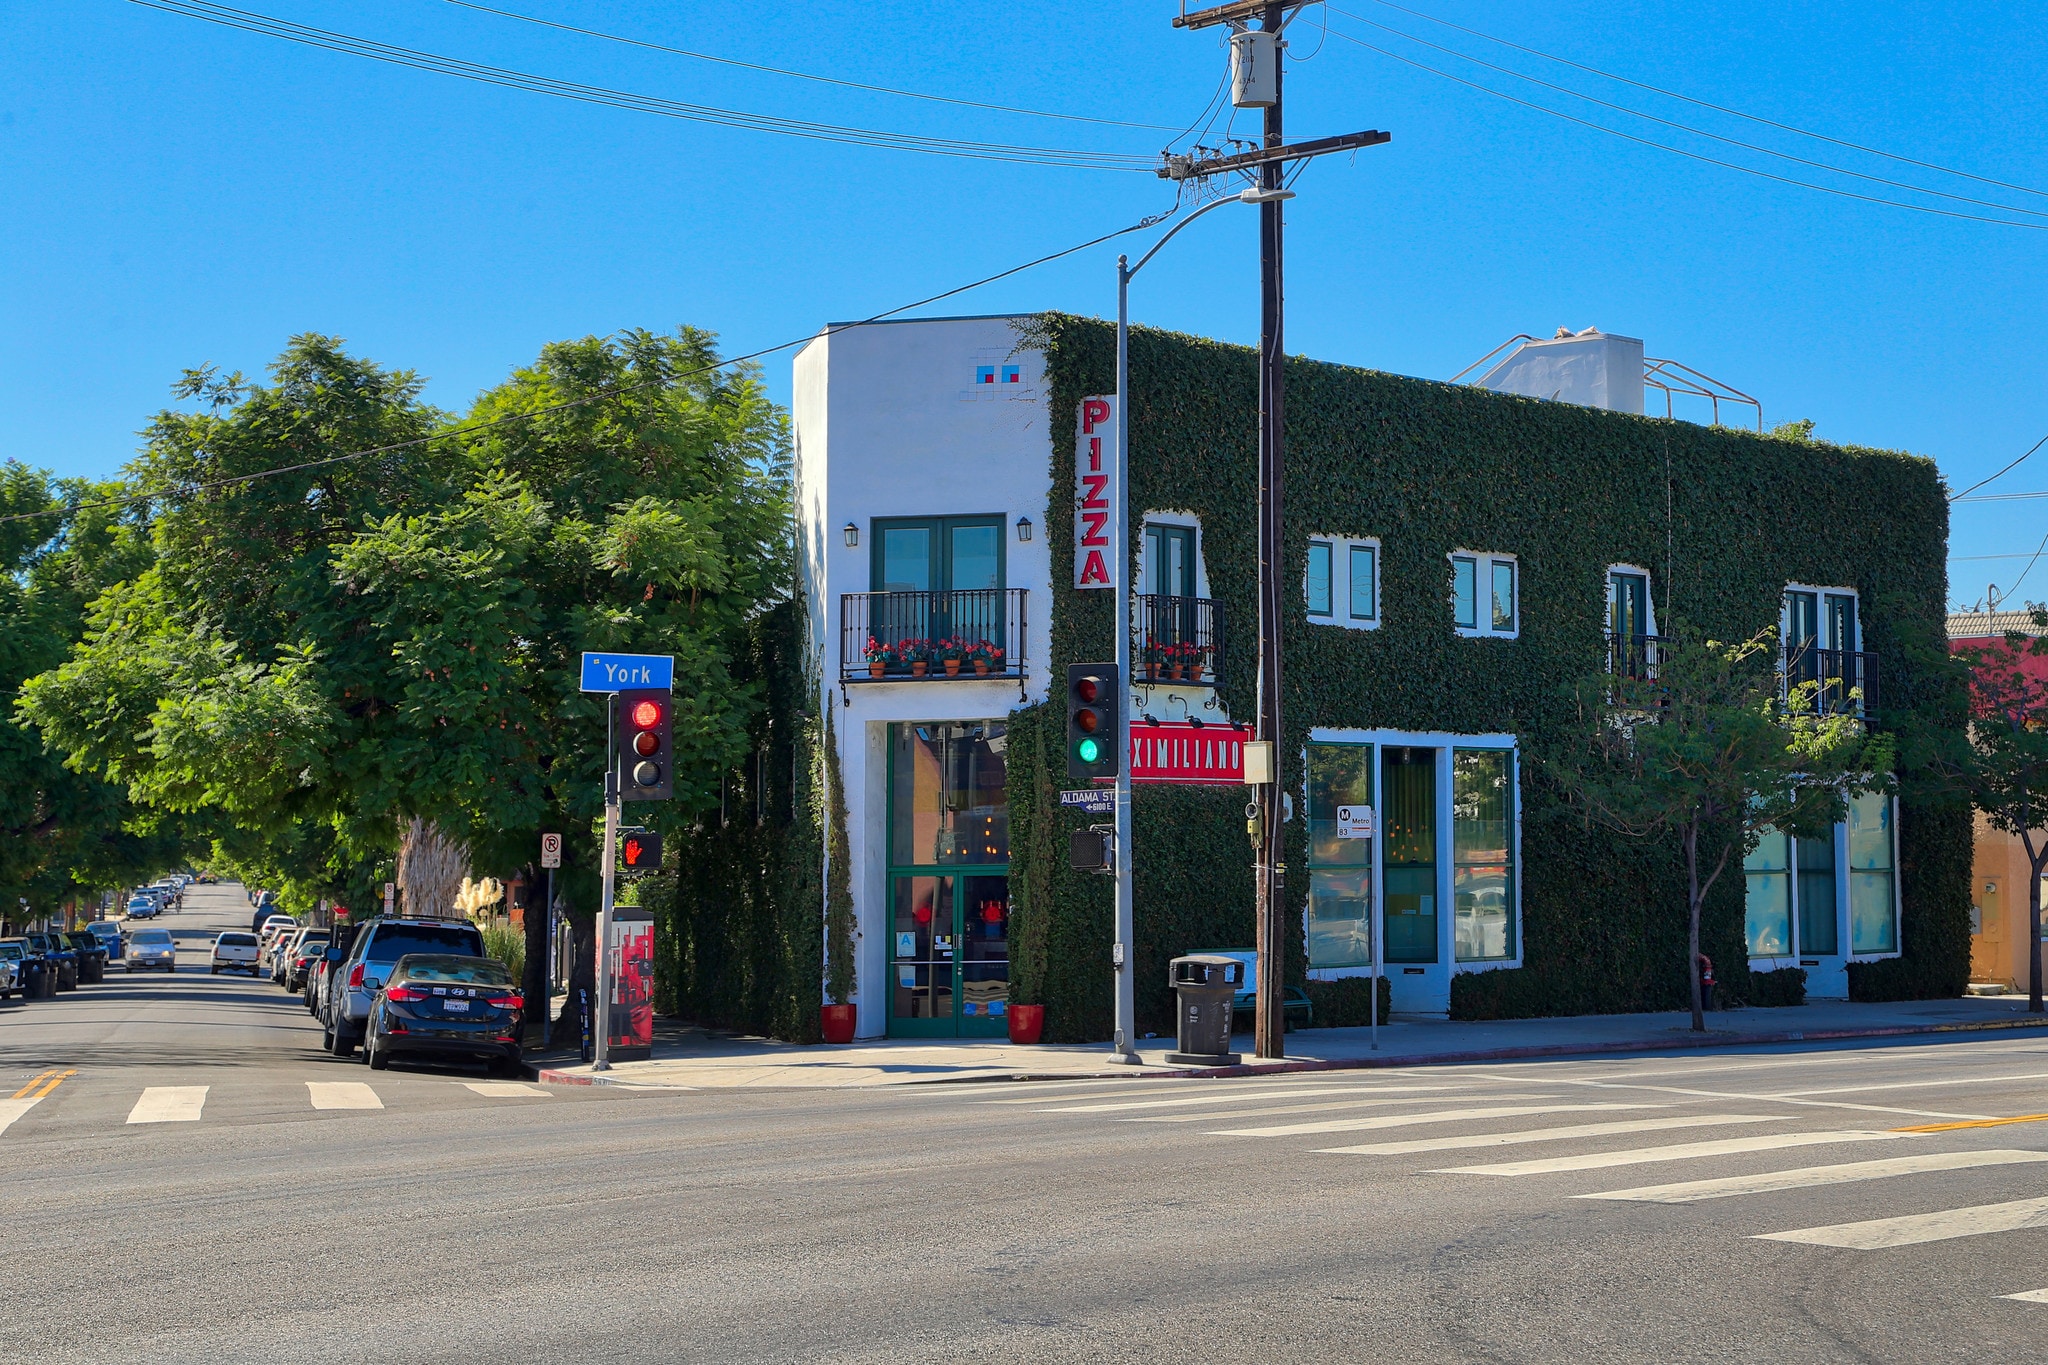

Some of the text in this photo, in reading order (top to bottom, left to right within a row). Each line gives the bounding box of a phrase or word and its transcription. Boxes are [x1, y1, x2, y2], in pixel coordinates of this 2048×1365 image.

[1080, 400, 1110, 584] PIZZA
[605, 663, 651, 684] York
[1133, 738, 1239, 769] XIMILIANO
[1061, 792, 1099, 804] ALDAMA
[1092, 803, 1106, 811] 6100
[1339, 828, 1348, 836] 83
[901, 934, 911, 945] A
